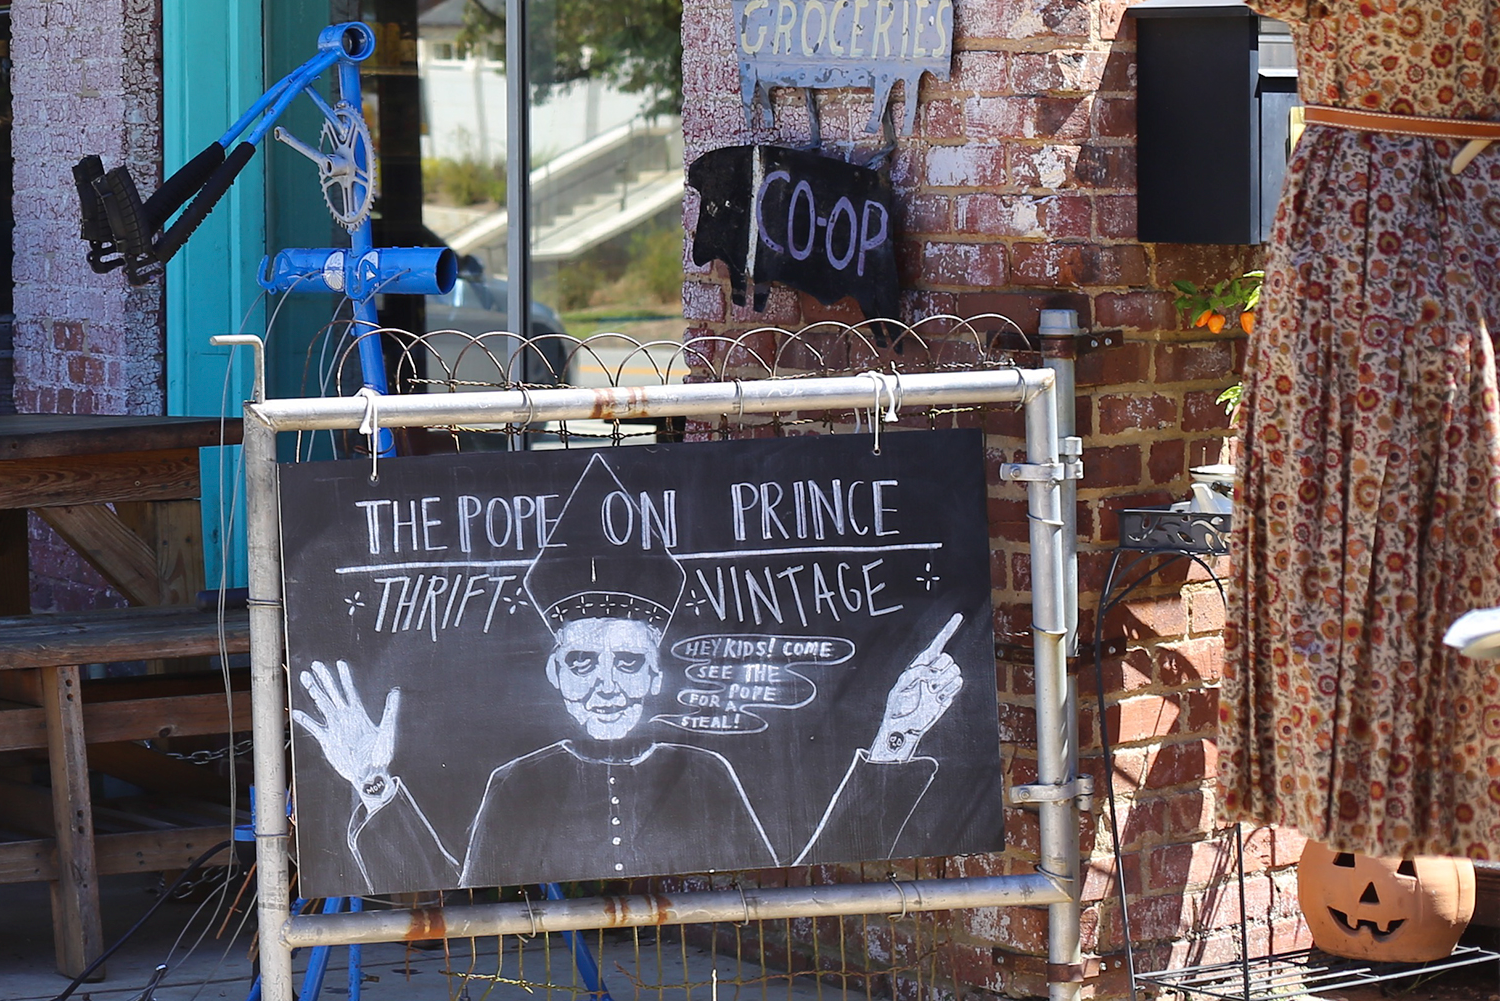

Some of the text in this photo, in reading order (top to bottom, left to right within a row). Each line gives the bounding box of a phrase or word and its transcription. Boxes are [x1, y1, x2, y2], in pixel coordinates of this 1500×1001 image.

[756, 170, 888, 277] CO-OP
[355, 479, 900, 554] THE POPE ON PRINCE
[374, 558, 904, 642] THRIFT VINTAGE
[685, 637, 834, 658] HEY KIDS! COME
[697, 664, 781, 683] SEE THE
[689, 692, 738, 712] FOR A
[728, 683, 778, 702] POPE
[681, 714, 741, 730] STEAL!
[365, 780, 385, 795] MOM
